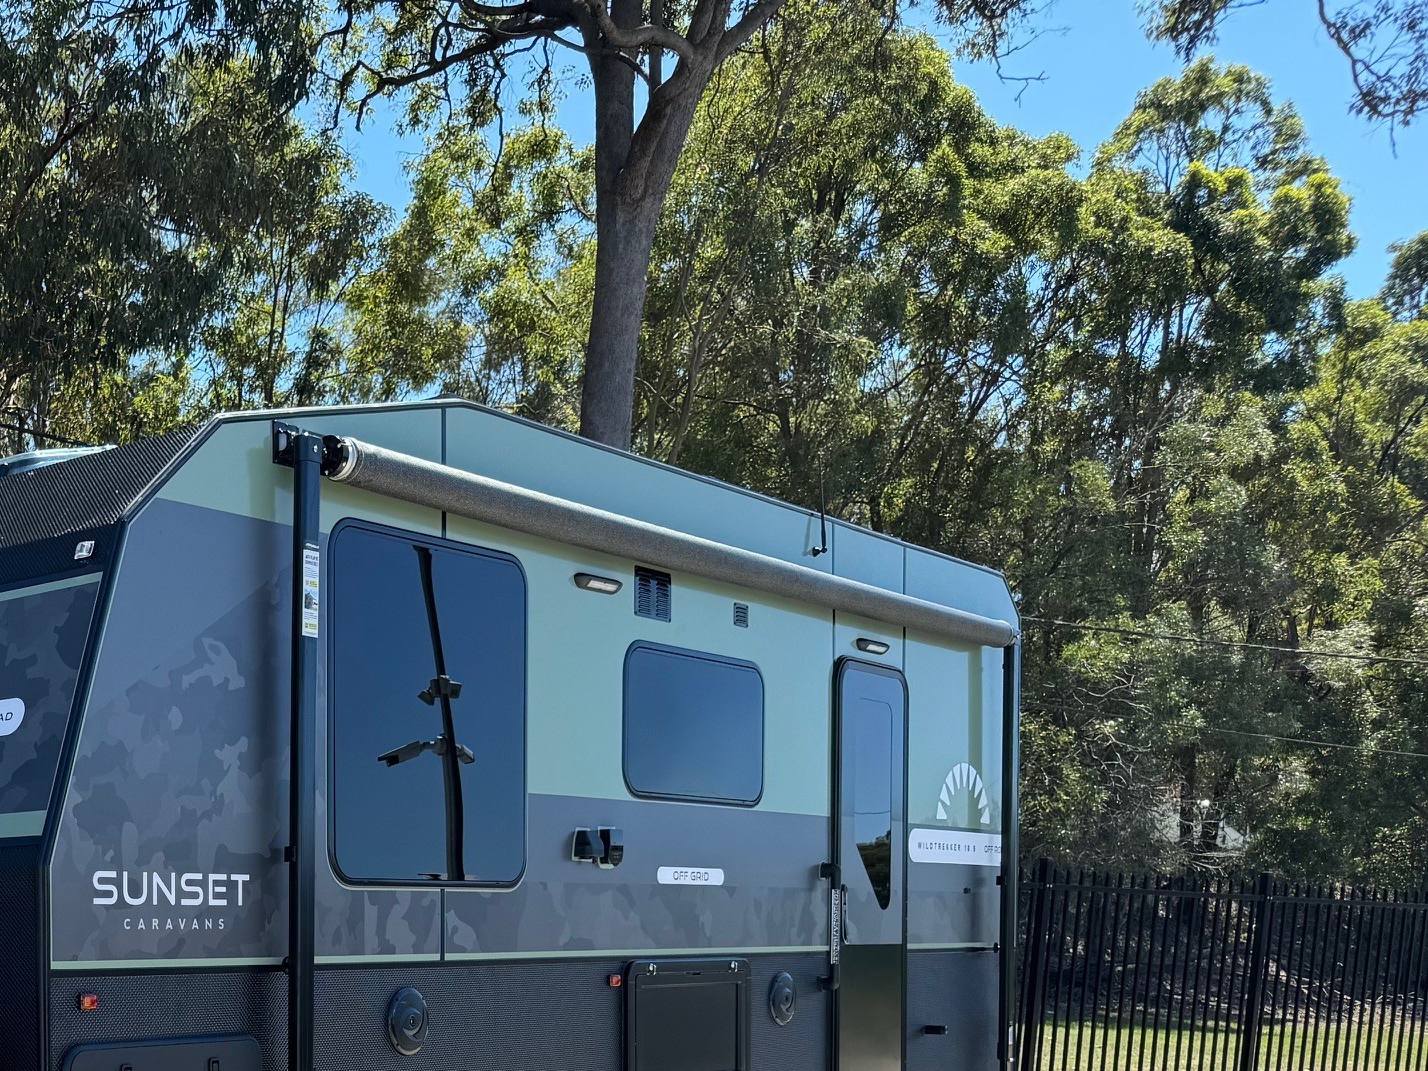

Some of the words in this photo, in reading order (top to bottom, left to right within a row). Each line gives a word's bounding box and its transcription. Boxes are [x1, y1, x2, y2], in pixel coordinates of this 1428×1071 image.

[917, 841, 961, 852] WILDTREKKER
[983, 845, 994, 853] OFF
[672, 870, 689, 881] OFF
[689, 871, 710, 882] GRID
[92, 870, 250, 906] SUNSET
[123, 918, 225, 930] CARAVANS
